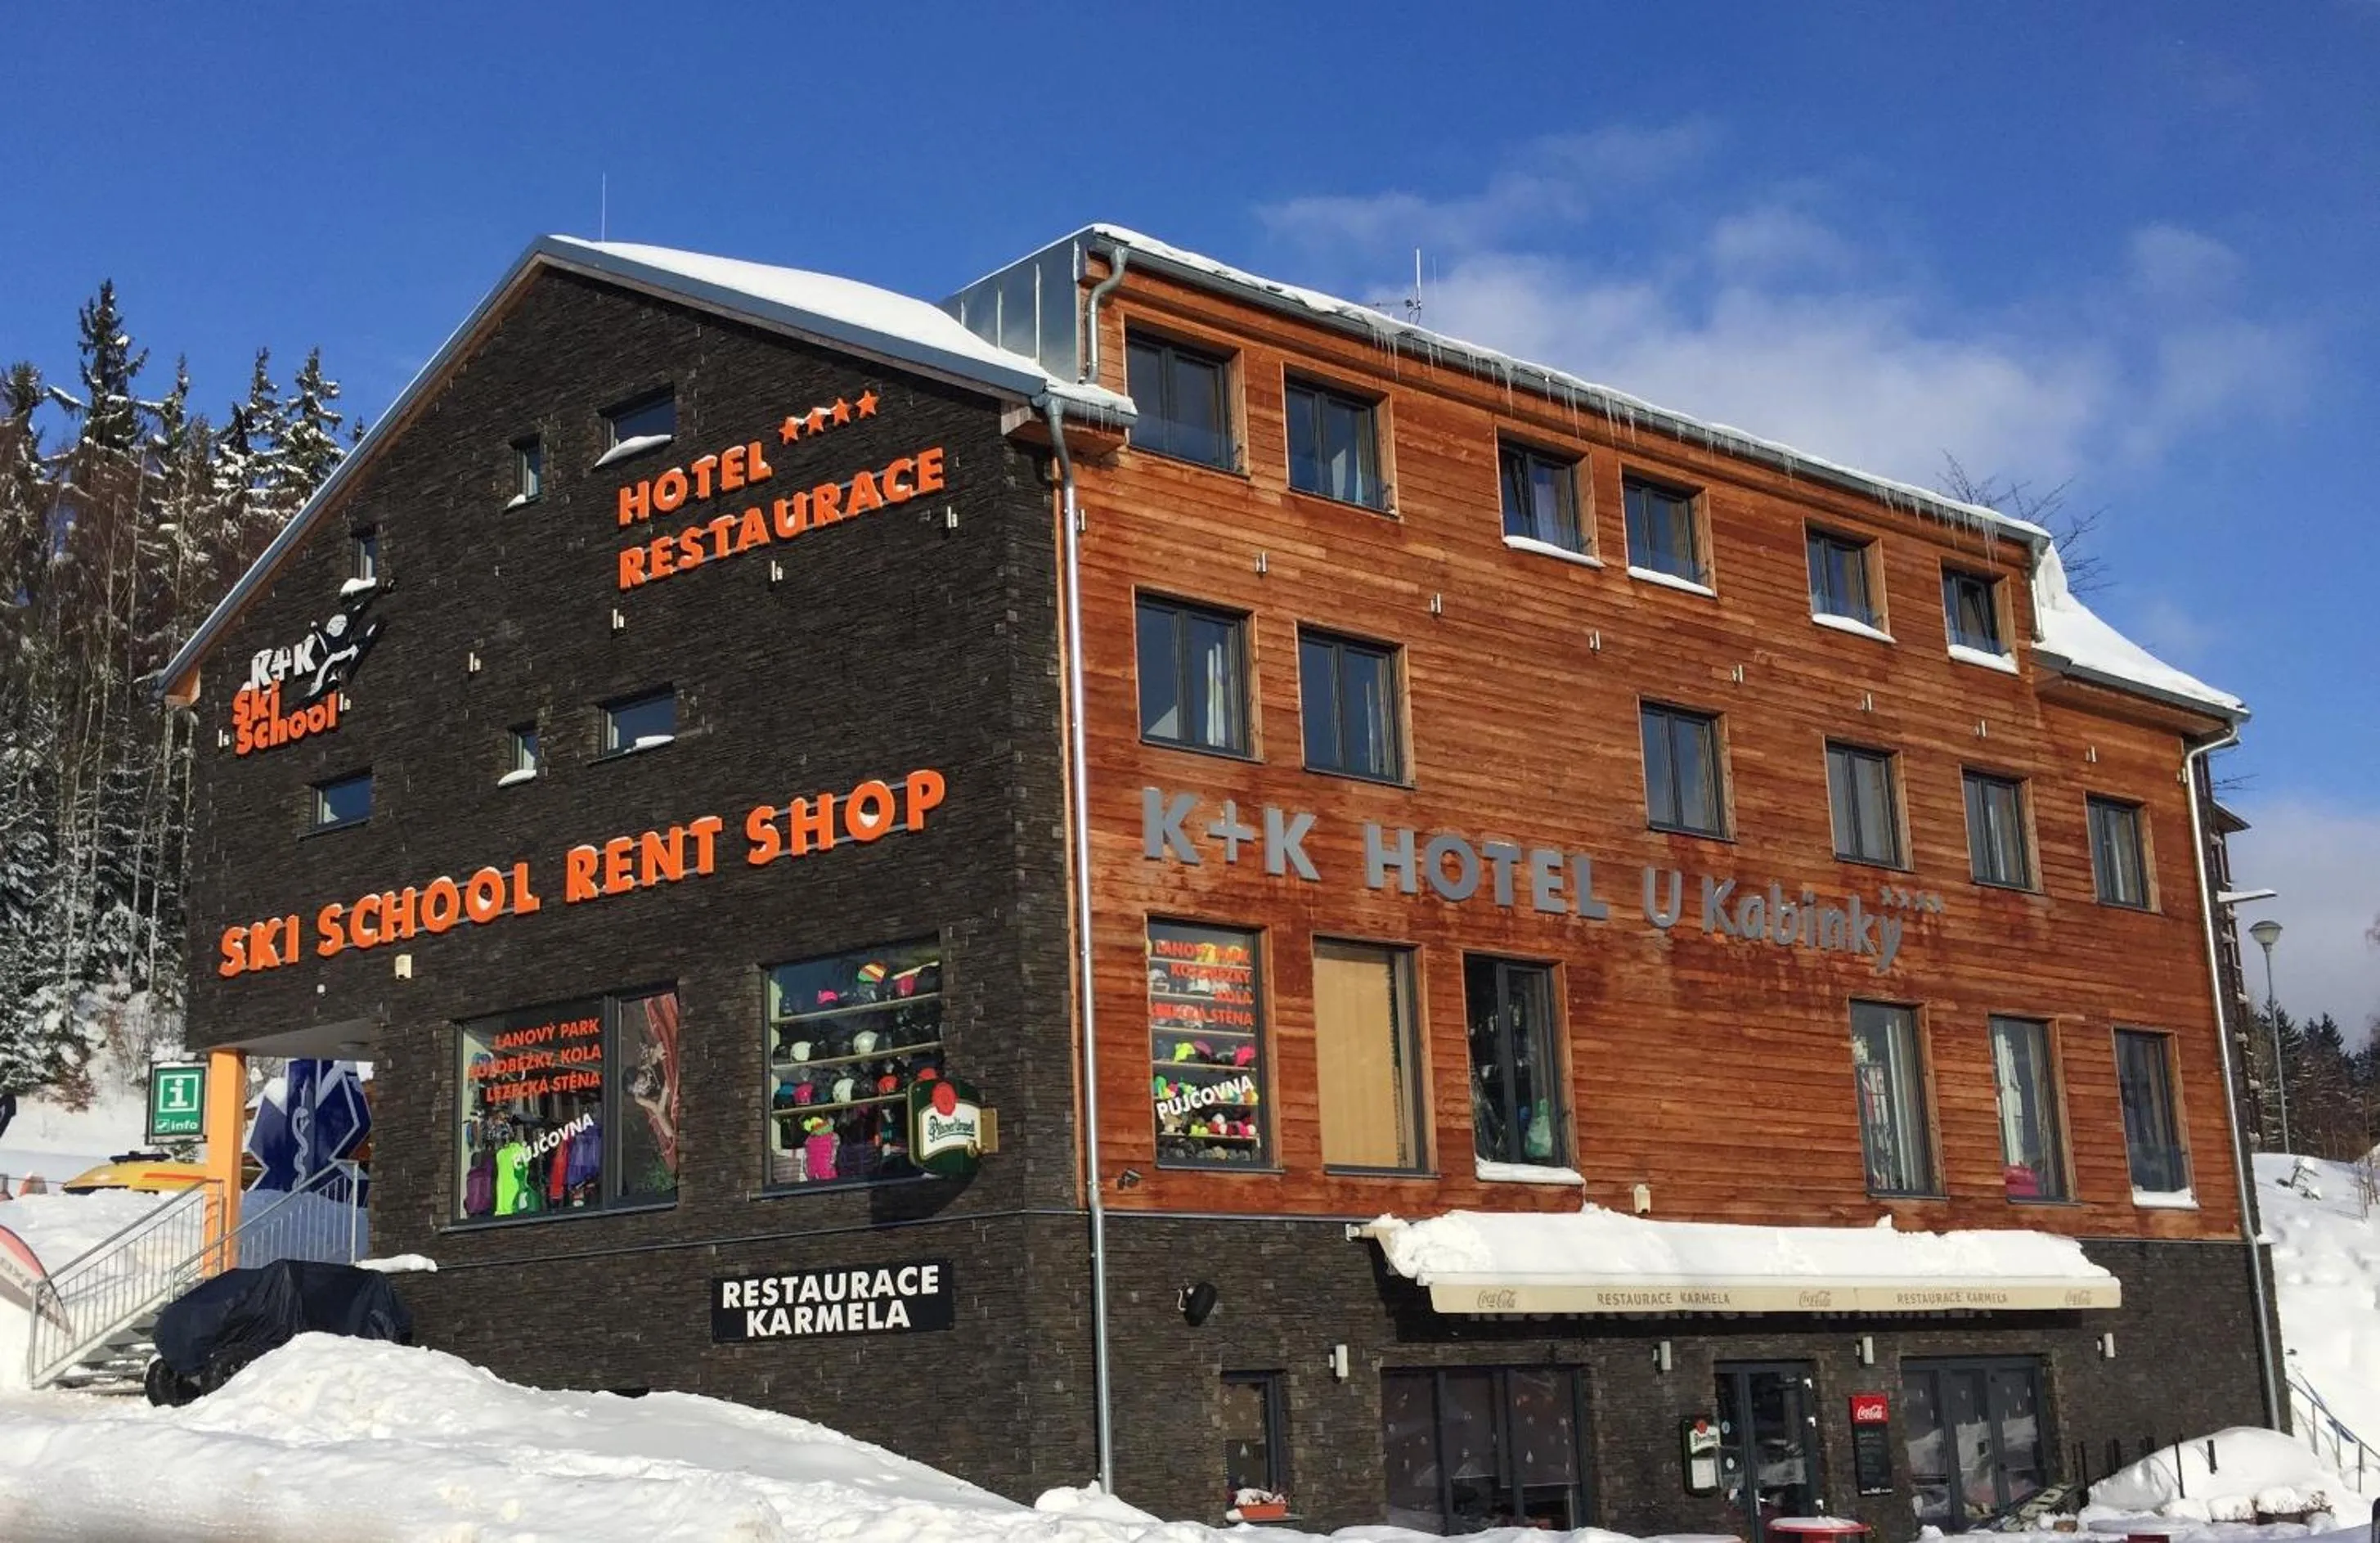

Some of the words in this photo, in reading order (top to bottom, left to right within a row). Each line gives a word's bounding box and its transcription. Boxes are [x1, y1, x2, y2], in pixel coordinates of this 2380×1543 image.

[619, 442, 772, 525] HOTEL
[619, 447, 944, 590] RESTAURACE
[218, 915, 299, 978] SKI
[317, 862, 541, 956] SCHOOL
[566, 815, 723, 903] RENT
[746, 768, 945, 865] SHOP
[1143, 786, 1322, 882] K+K
[1364, 821, 1610, 921] HOTEL
[1643, 866, 1682, 929] U
[1701, 875, 1903, 974] Kabinky
[495, 1023, 556, 1050] LANOVÝ
[560, 1018, 600, 1039] PARK
[560, 1043, 603, 1064] KOLA
[722, 1265, 939, 1309] RESTAURACE
[1596, 1292, 1673, 1307] RESTAURACE
[1679, 1291, 1731, 1305] KARMELA
[1896, 1292, 1963, 1306] RESTAURACE
[1966, 1291, 2009, 1305] KARMELA
[746, 1299, 911, 1337] KARMELA
